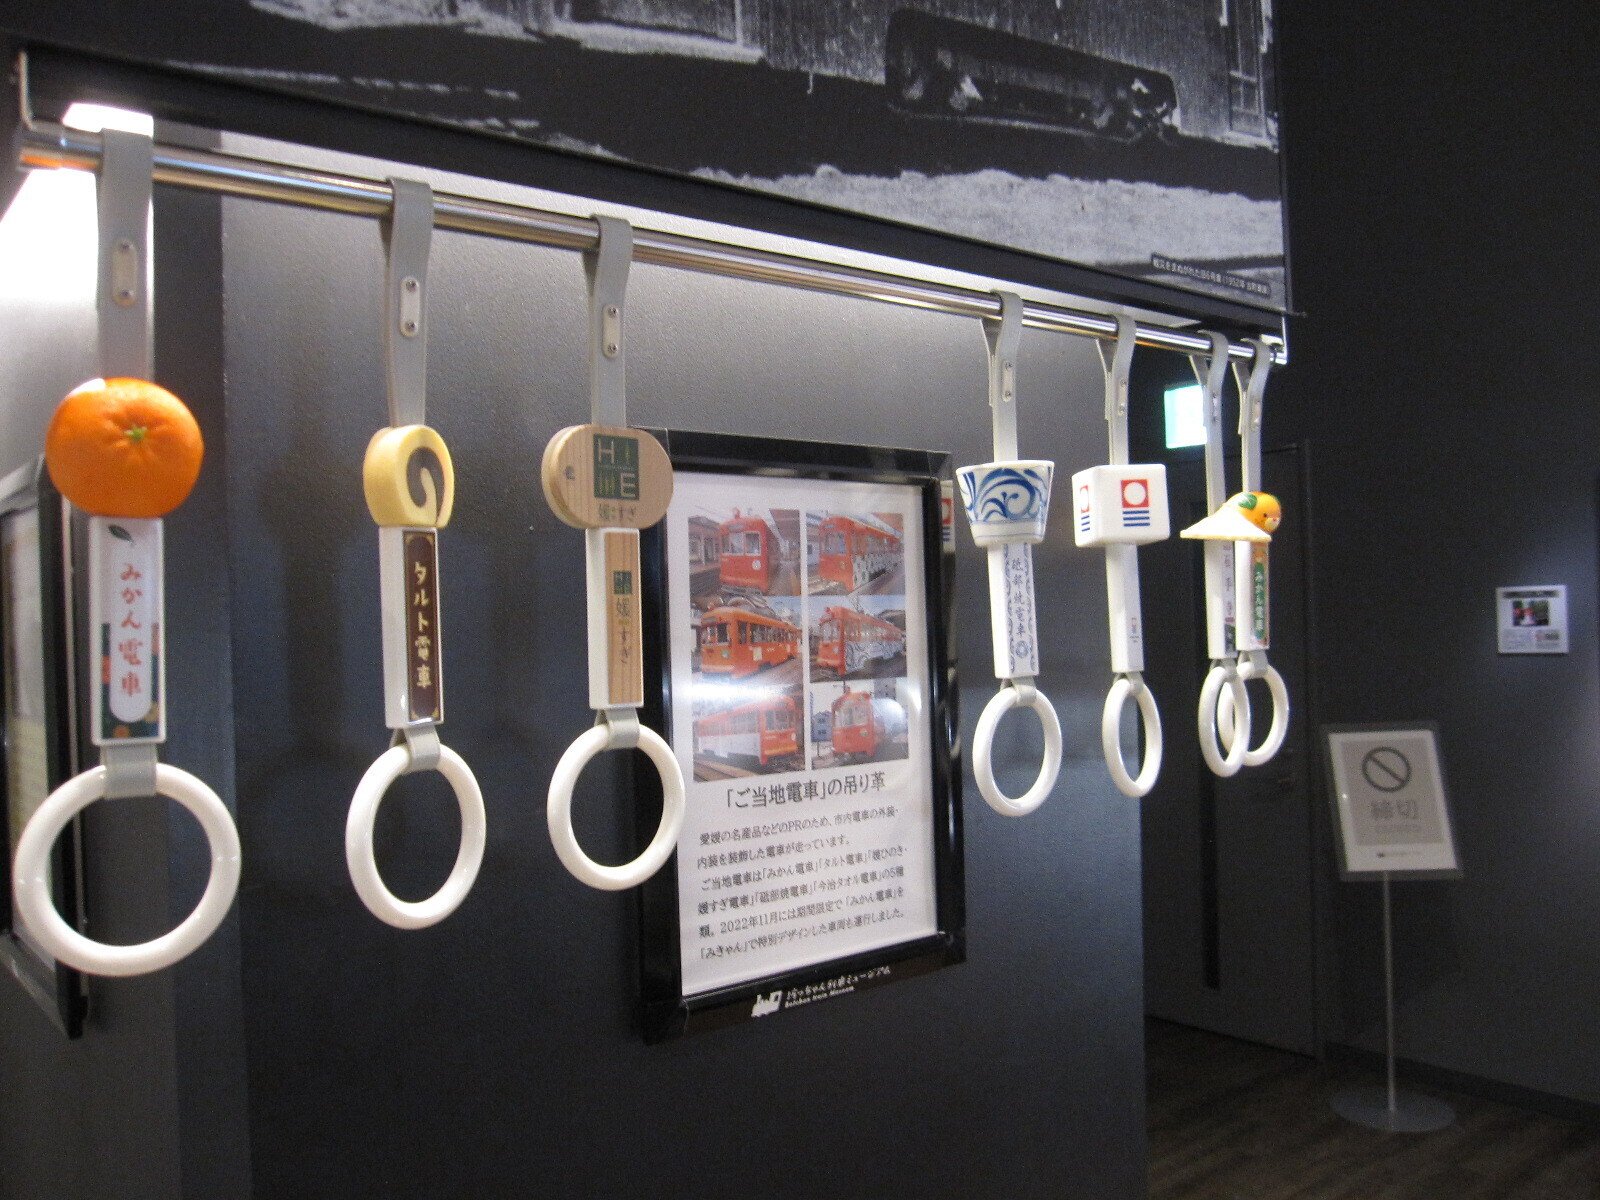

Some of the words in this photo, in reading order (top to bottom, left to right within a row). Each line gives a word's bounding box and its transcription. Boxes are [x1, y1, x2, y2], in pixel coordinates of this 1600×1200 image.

[118, 563, 142, 697] みかん電車
[414, 561, 432, 688] タルト電車
[727, 770, 886, 808] 「ご当地電車」の吊り革
